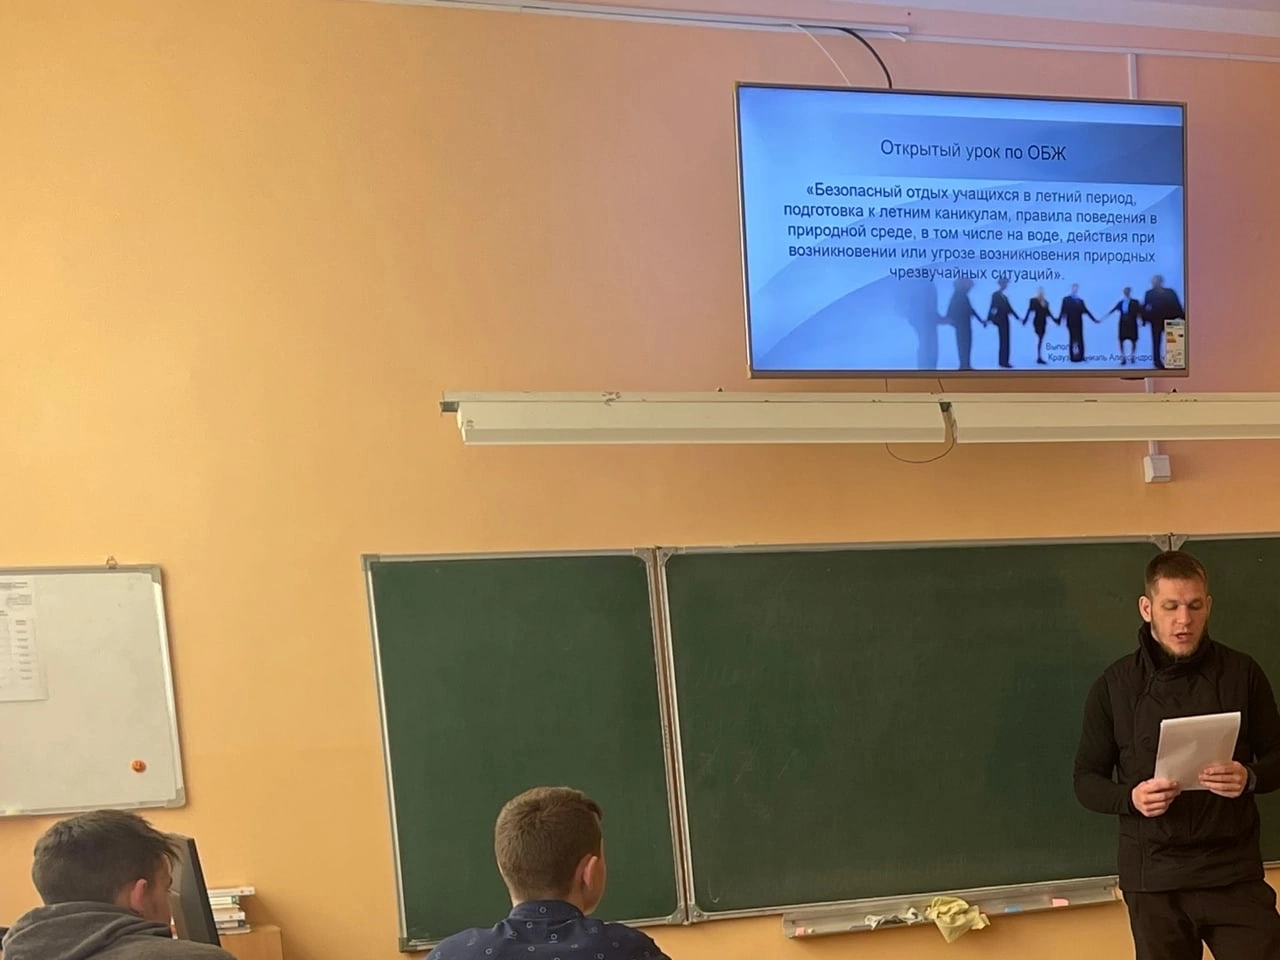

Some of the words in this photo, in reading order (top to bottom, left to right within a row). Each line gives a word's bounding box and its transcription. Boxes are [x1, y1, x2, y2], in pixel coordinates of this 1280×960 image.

[880, 139, 961, 158] Открытый
[966, 145, 1001, 161] урок
[1004, 147, 1023, 160] по
[1027, 144, 1067, 161] ОБЖ
[806, 182, 902, 198] «Безопасный
[906, 187, 948, 200] отдых
[952, 189, 1019, 203] учащихся
[1023, 192, 1031, 201] в
[1035, 190, 1082, 204] летний
[1086, 193, 1137, 206] период,
[784, 204, 864, 218] подготовка
[868, 208, 876, 218] к
[879, 206, 931, 219] летним
[935, 208, 1012, 223] каникулам,
[1016, 210, 1072, 223] правила
[1076, 212, 1146, 225] поведения
[1150, 214, 1157, 224] в
[788, 224, 866, 240] природной
[870, 228, 917, 241] среде,
[921, 228, 929, 239] в
[933, 228, 959, 240] том
[962, 229, 1003, 241] числе
[1007, 231, 1023, 241] на
[1027, 231, 1063, 244] воде,
[1066, 231, 1128, 244] действия
[1132, 233, 1155, 245] при
[788, 245, 896, 257] возникновении
[901, 247, 927, 259] или
[931, 248, 975, 262] угрозе
[979, 249, 1080, 262] возникновения
[1084, 251, 1156, 264] природных
[889, 266, 987, 281] чрезвучайных
[991, 268, 1065, 284] ситуаций».
